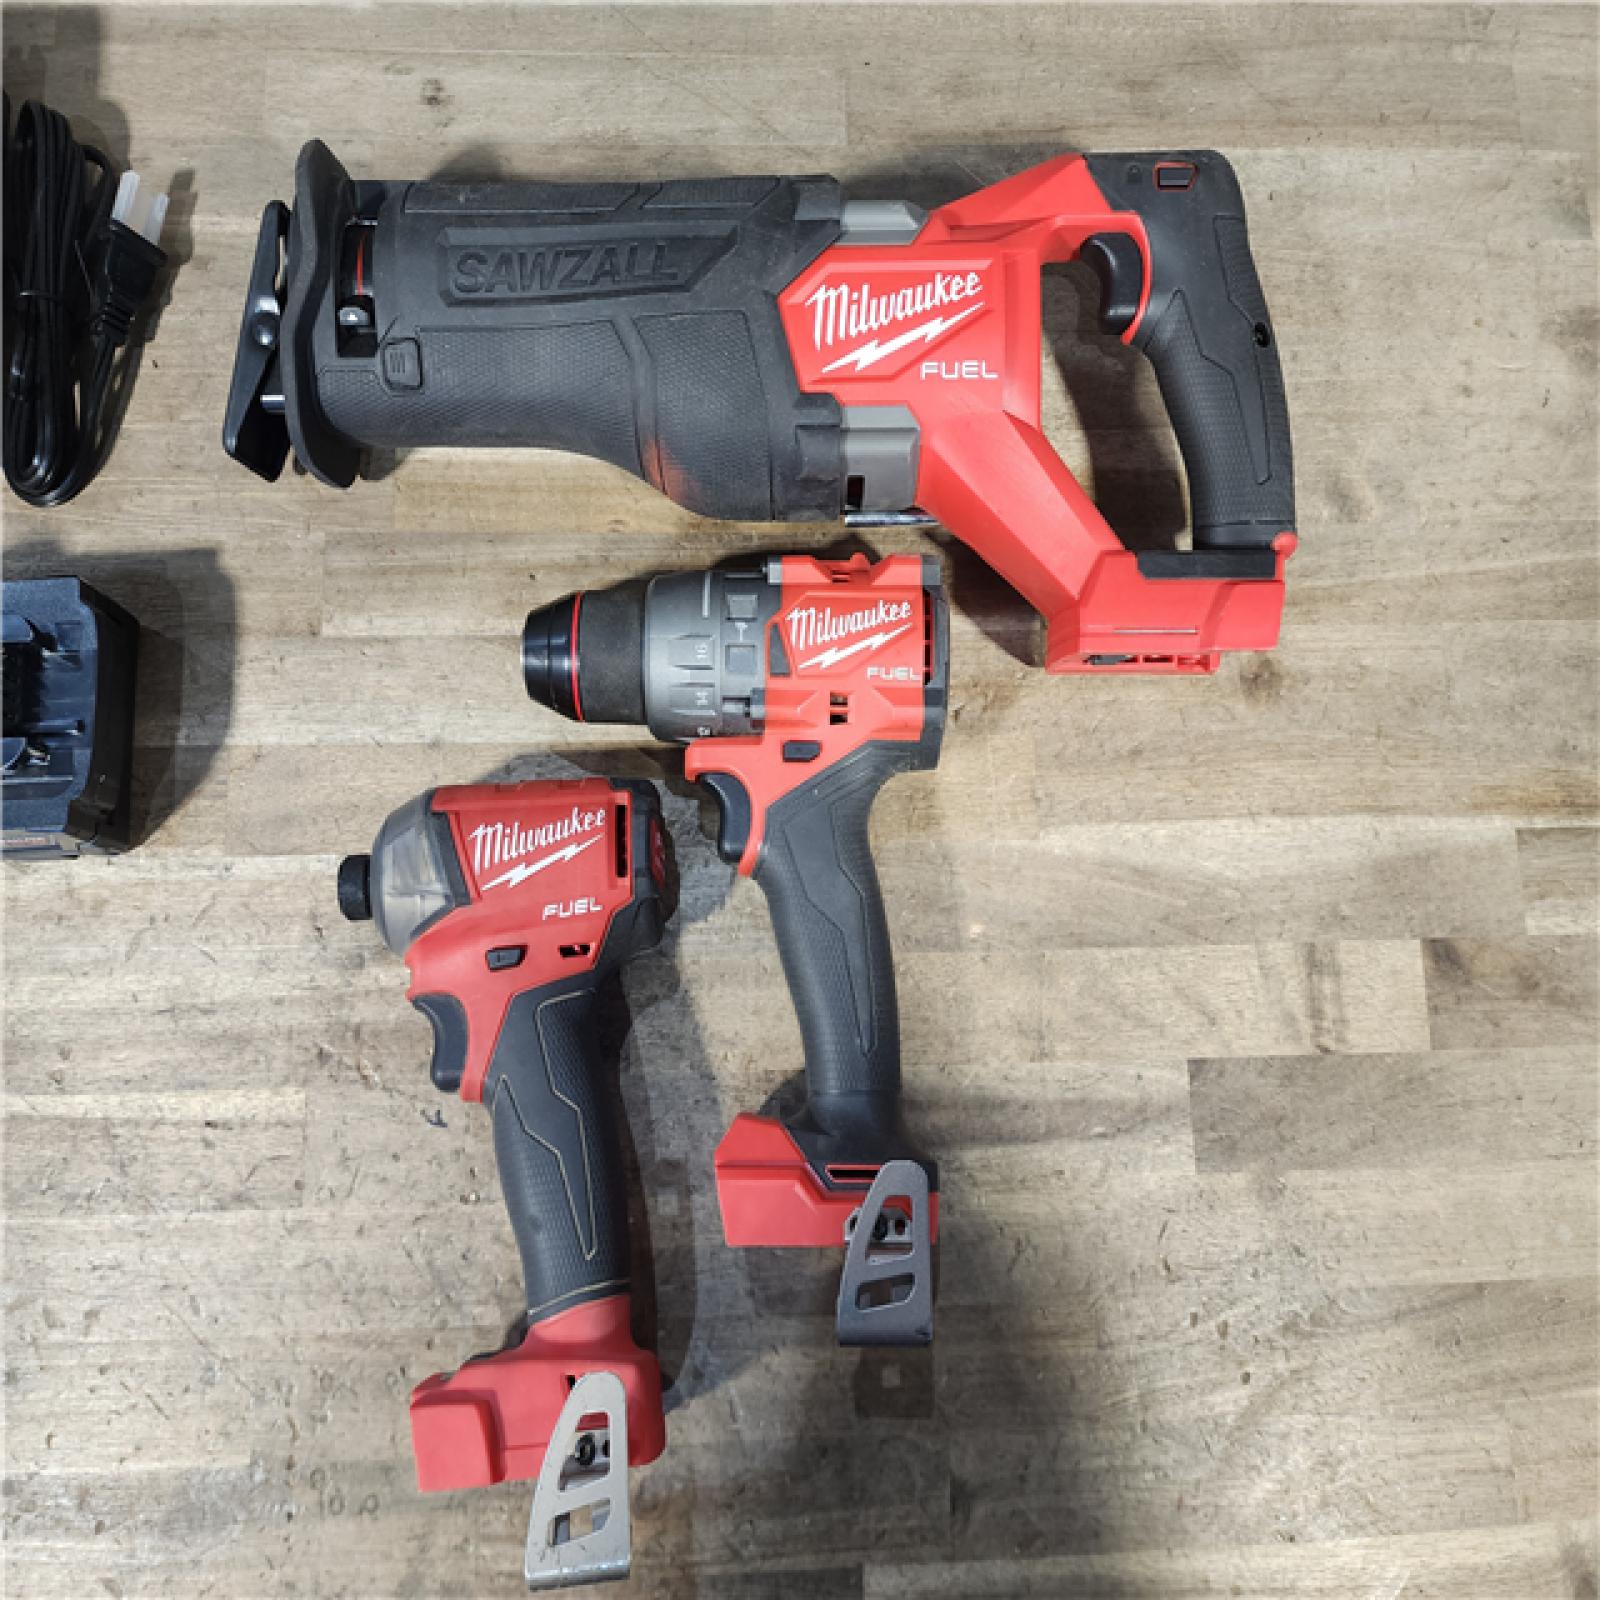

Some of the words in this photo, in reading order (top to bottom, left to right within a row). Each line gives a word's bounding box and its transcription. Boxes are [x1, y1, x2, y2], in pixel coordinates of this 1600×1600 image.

[454, 243, 679, 293] SAWZALL
[805, 271, 984, 352] Milwaukee
[920, 360, 998, 380] FUEL
[785, 600, 912, 650] Milwaukee
[866, 667, 920, 681] FUEL
[468, 806, 606, 876] Milwaukee
[542, 897, 602, 920] FUEL
